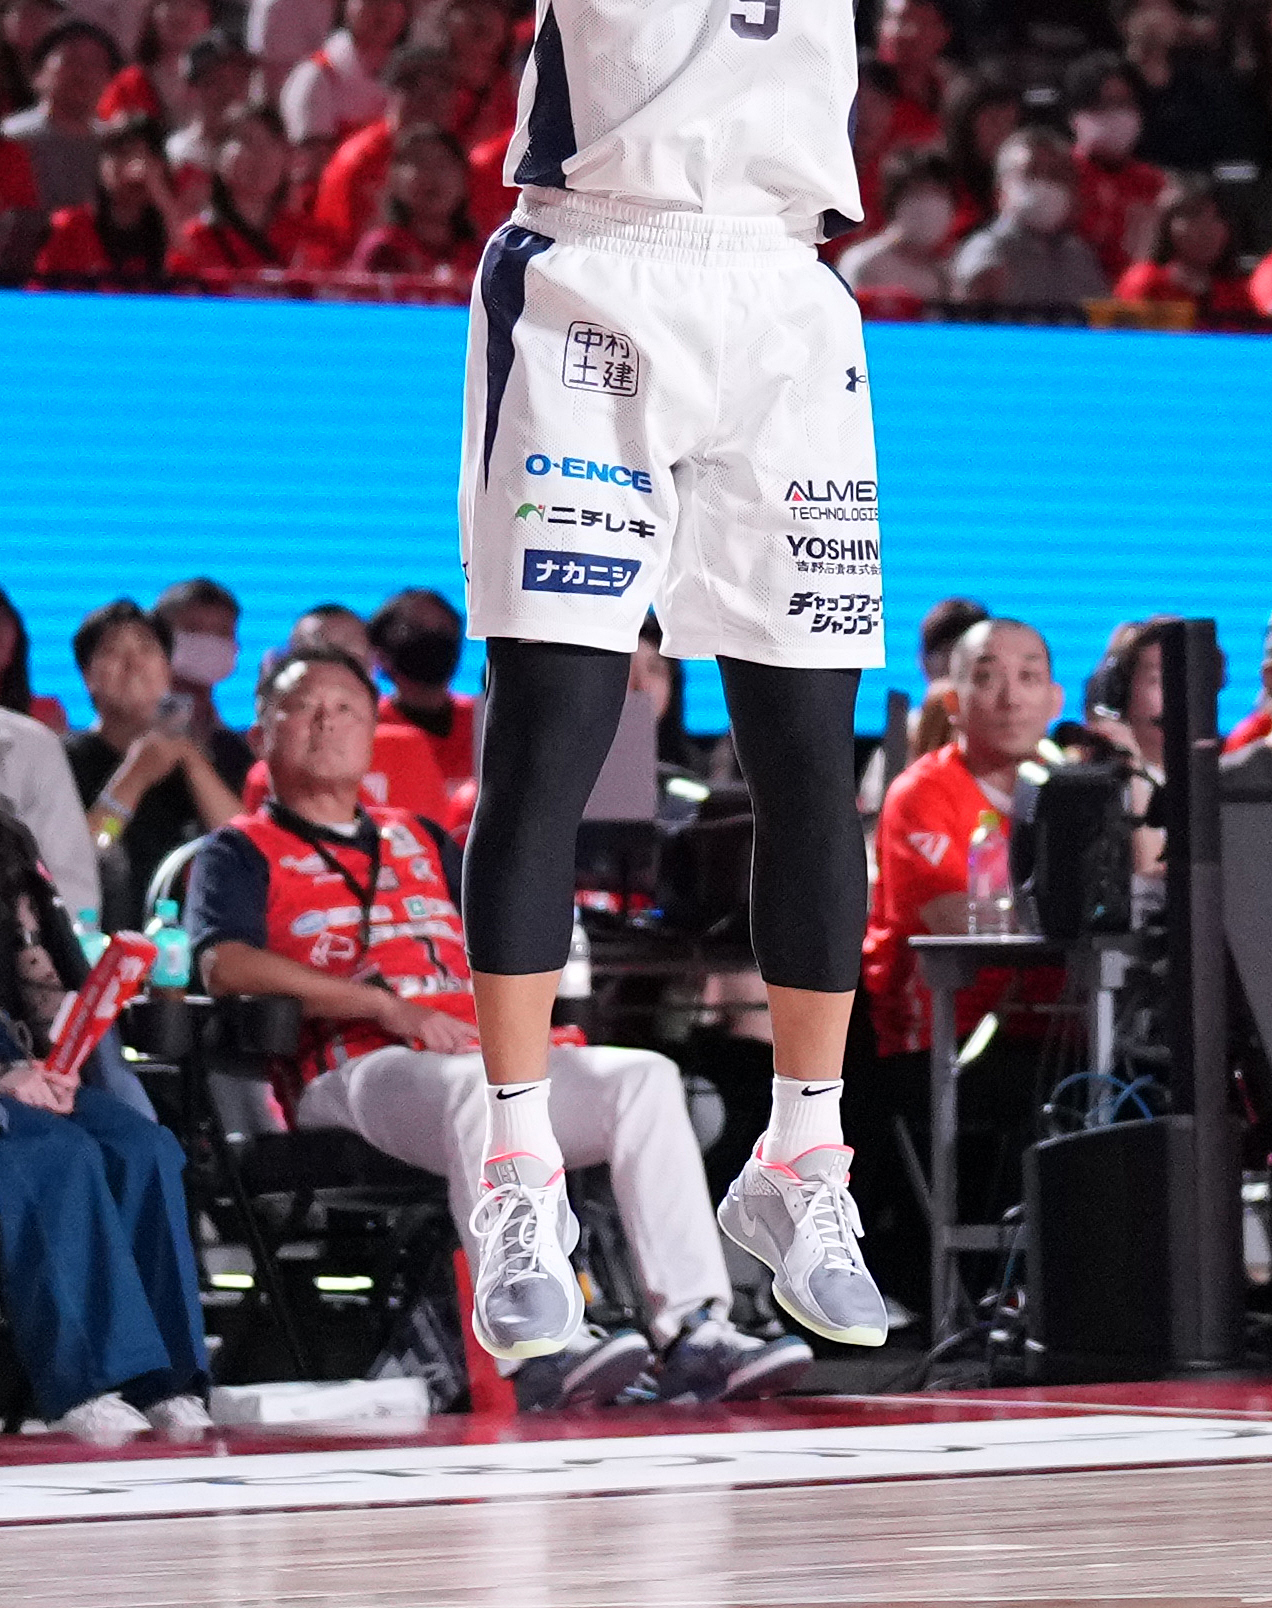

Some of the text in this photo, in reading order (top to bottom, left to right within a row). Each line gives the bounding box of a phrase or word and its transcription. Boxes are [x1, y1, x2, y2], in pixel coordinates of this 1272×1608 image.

[574, 328, 630, 359] 中村
[569, 355, 635, 391] 土建
[525, 453, 653, 494] O-ENCE
[547, 506, 656, 539] ニチレキ
[786, 534, 880, 561] YOSHIN
[536, 559, 632, 589] ナカニシ
[796, 560, 882, 576] 吉野石膏株式会
[786, 591, 883, 616] チャップアッ
